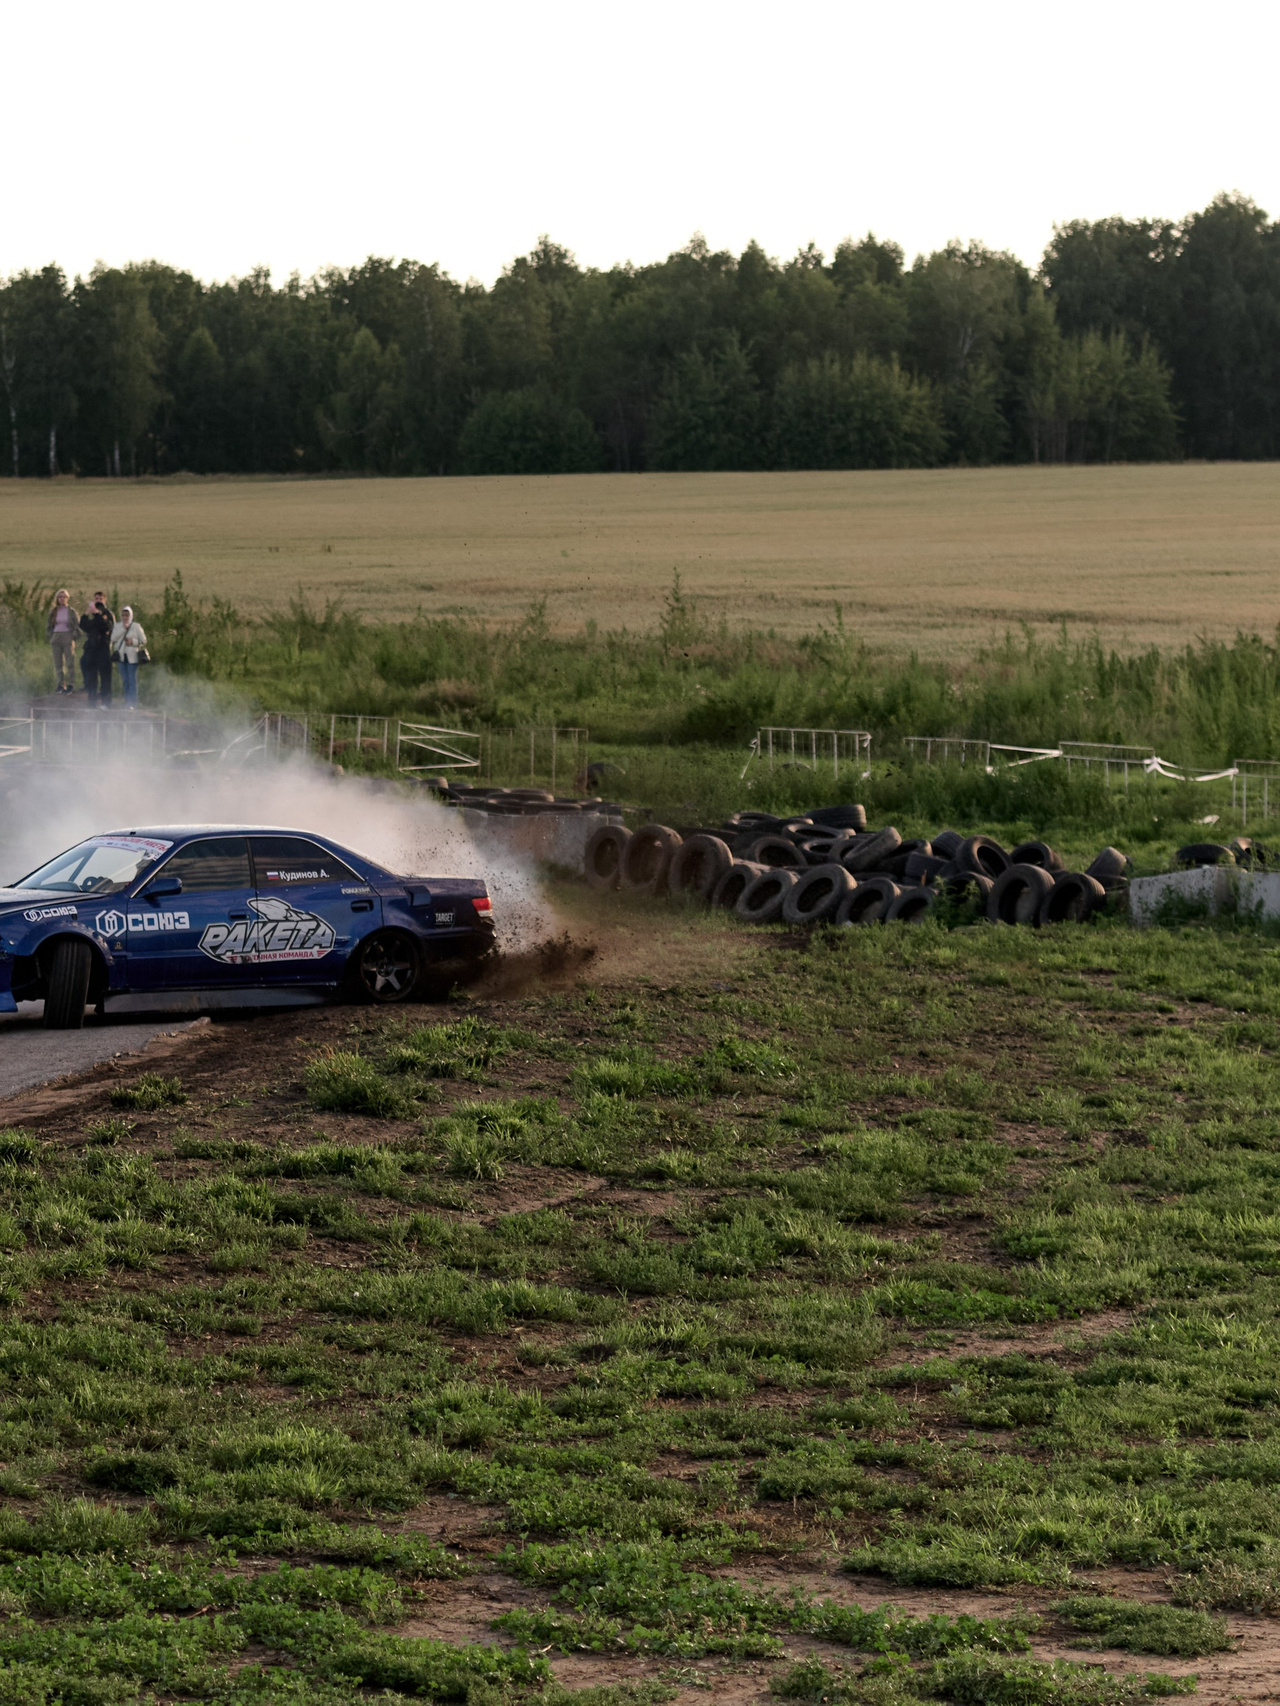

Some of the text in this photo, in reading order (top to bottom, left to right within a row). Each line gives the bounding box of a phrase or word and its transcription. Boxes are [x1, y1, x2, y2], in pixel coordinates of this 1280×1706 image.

[279, 869, 330, 881] Кудинов А.
[42, 905, 78, 918] СОЮЗ
[127, 911, 190, 931] СОЮЗ
[200, 920, 332, 956] РАКЕТА
[278, 950, 314, 960] КОМАНДА
